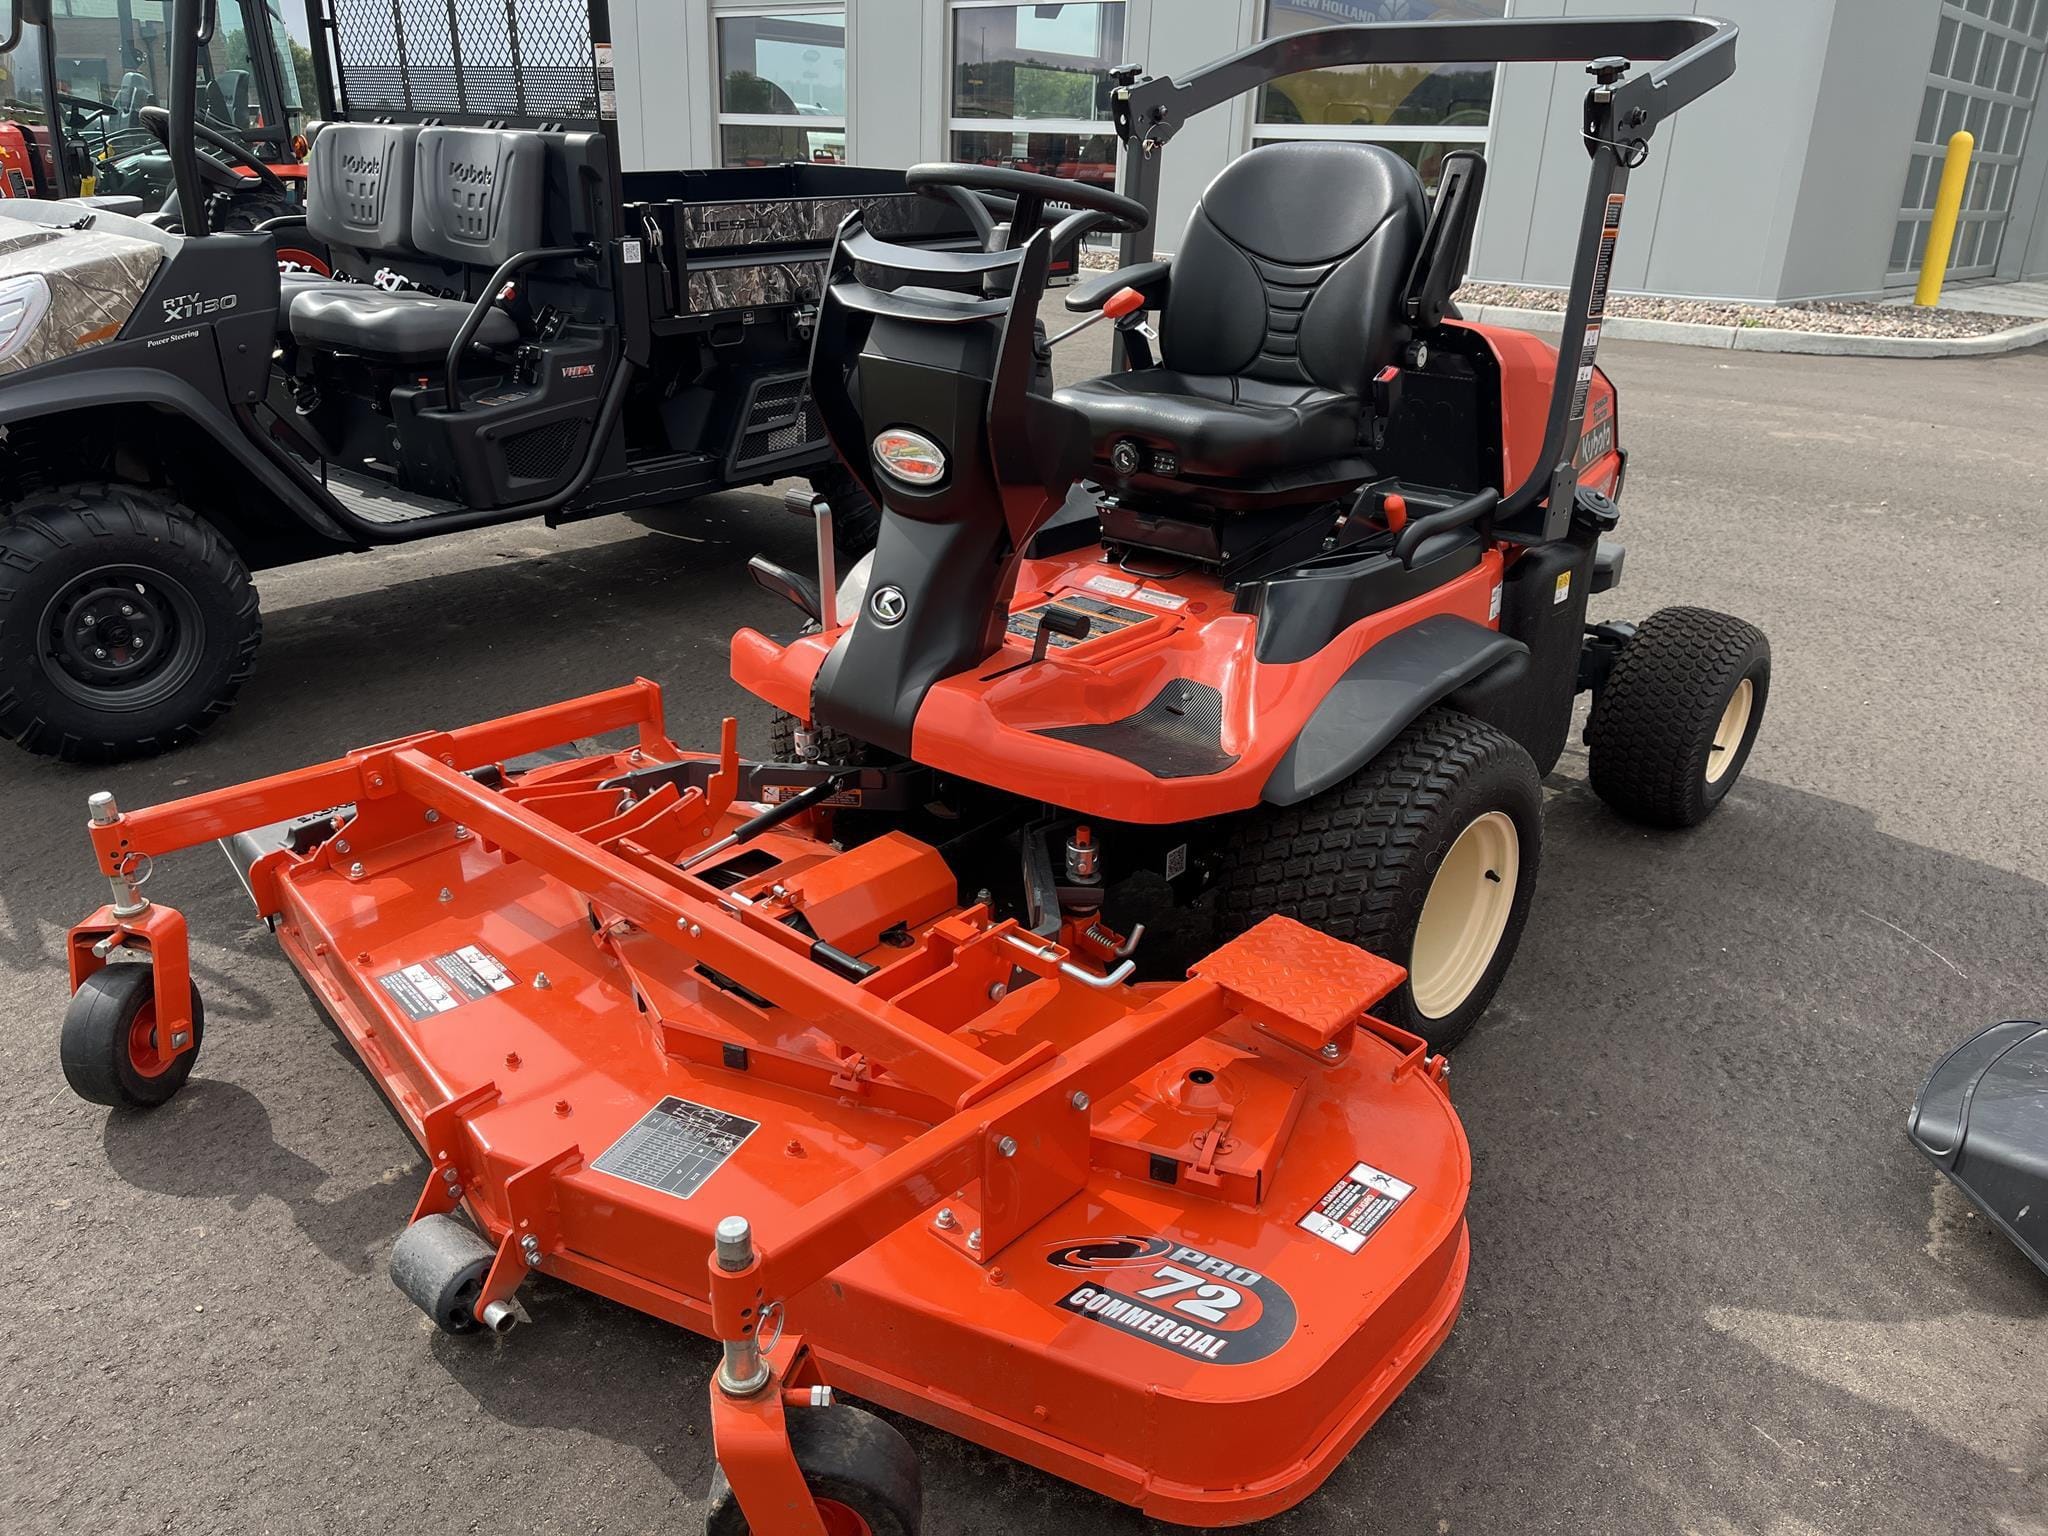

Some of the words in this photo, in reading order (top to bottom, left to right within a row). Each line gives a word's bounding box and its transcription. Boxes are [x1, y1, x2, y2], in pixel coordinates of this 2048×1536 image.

[162, 292, 200, 309] RTV
[164, 294, 237, 323] X1130
[147, 337, 170, 348] Power
[170, 330, 199, 343] Steering
[1582, 421, 1610, 462] Kubota
[1168, 1246, 1263, 1287] PRO
[1137, 1265, 1242, 1323] 72
[1068, 1287, 1228, 1360] COMMERCIAL
